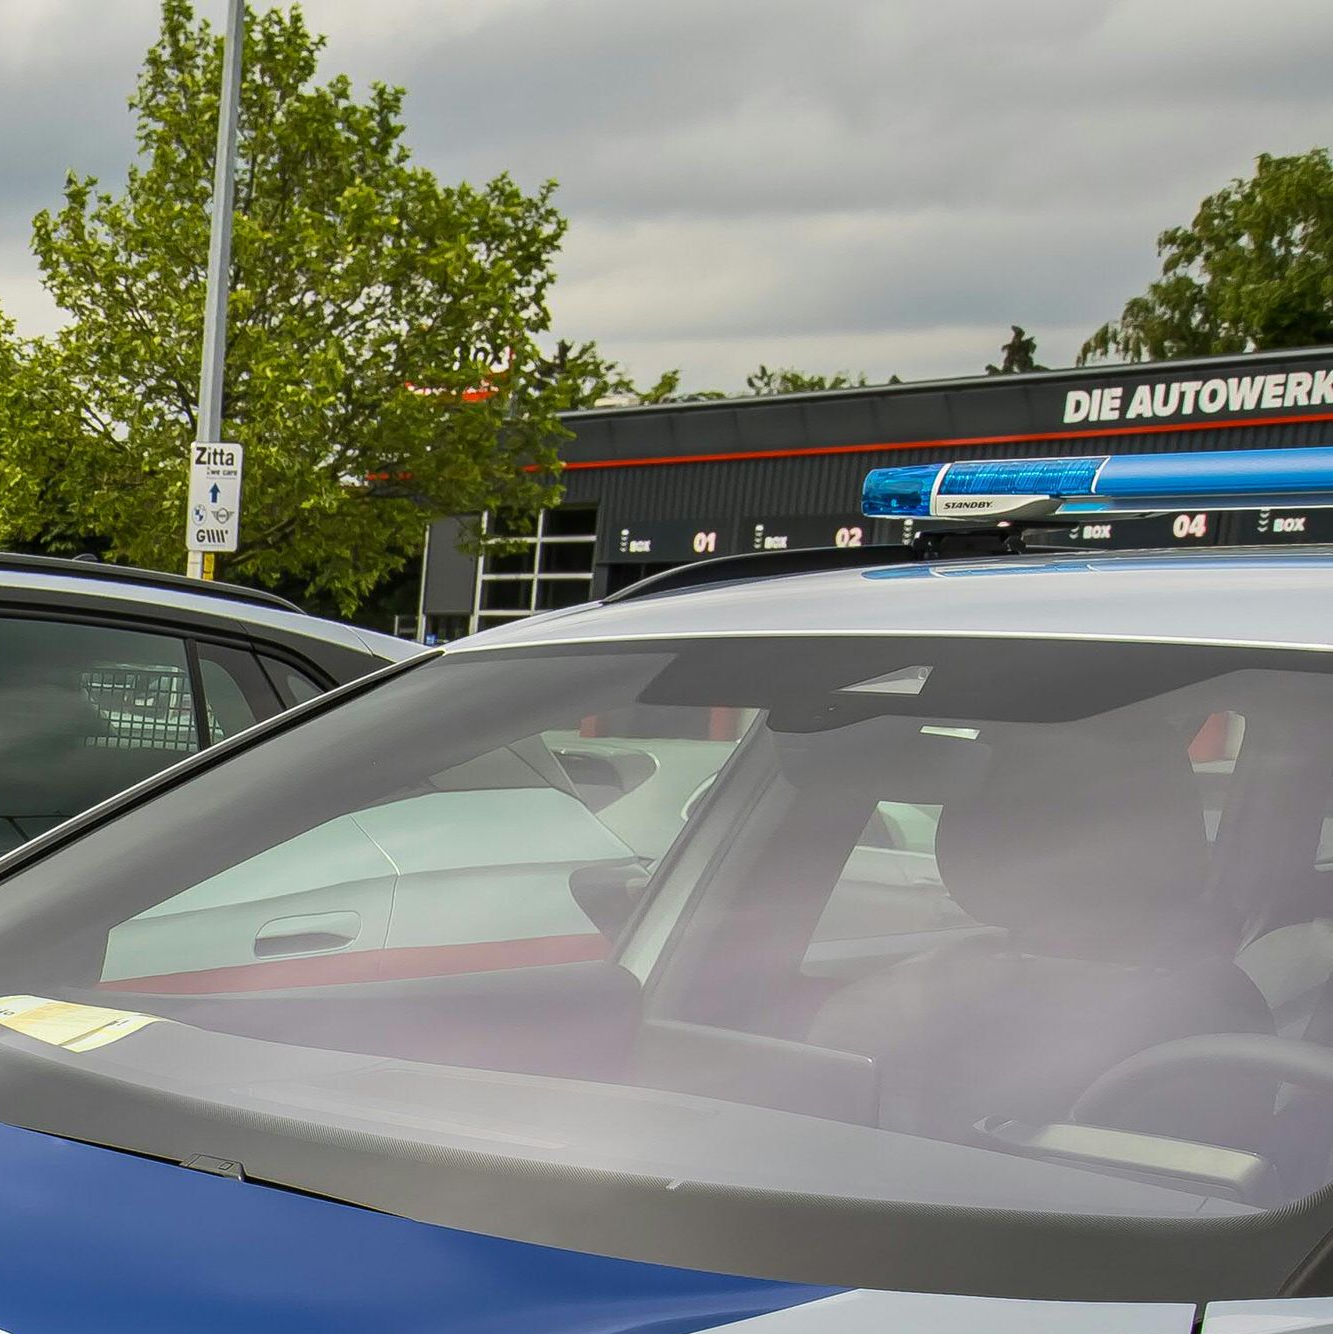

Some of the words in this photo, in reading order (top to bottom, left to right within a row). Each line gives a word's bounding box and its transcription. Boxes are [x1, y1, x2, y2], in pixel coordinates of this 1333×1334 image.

[1063, 387, 1123, 423] DIE
[195, 447, 234, 466] Zitta
[943, 501, 992, 510] STANDBY
[1083, 524, 1111, 539] BOX
[1173, 513, 1208, 538] 04
[1273, 517, 1306, 532] BOX
[693, 532, 716, 552] 01
[835, 527, 863, 547] 02
